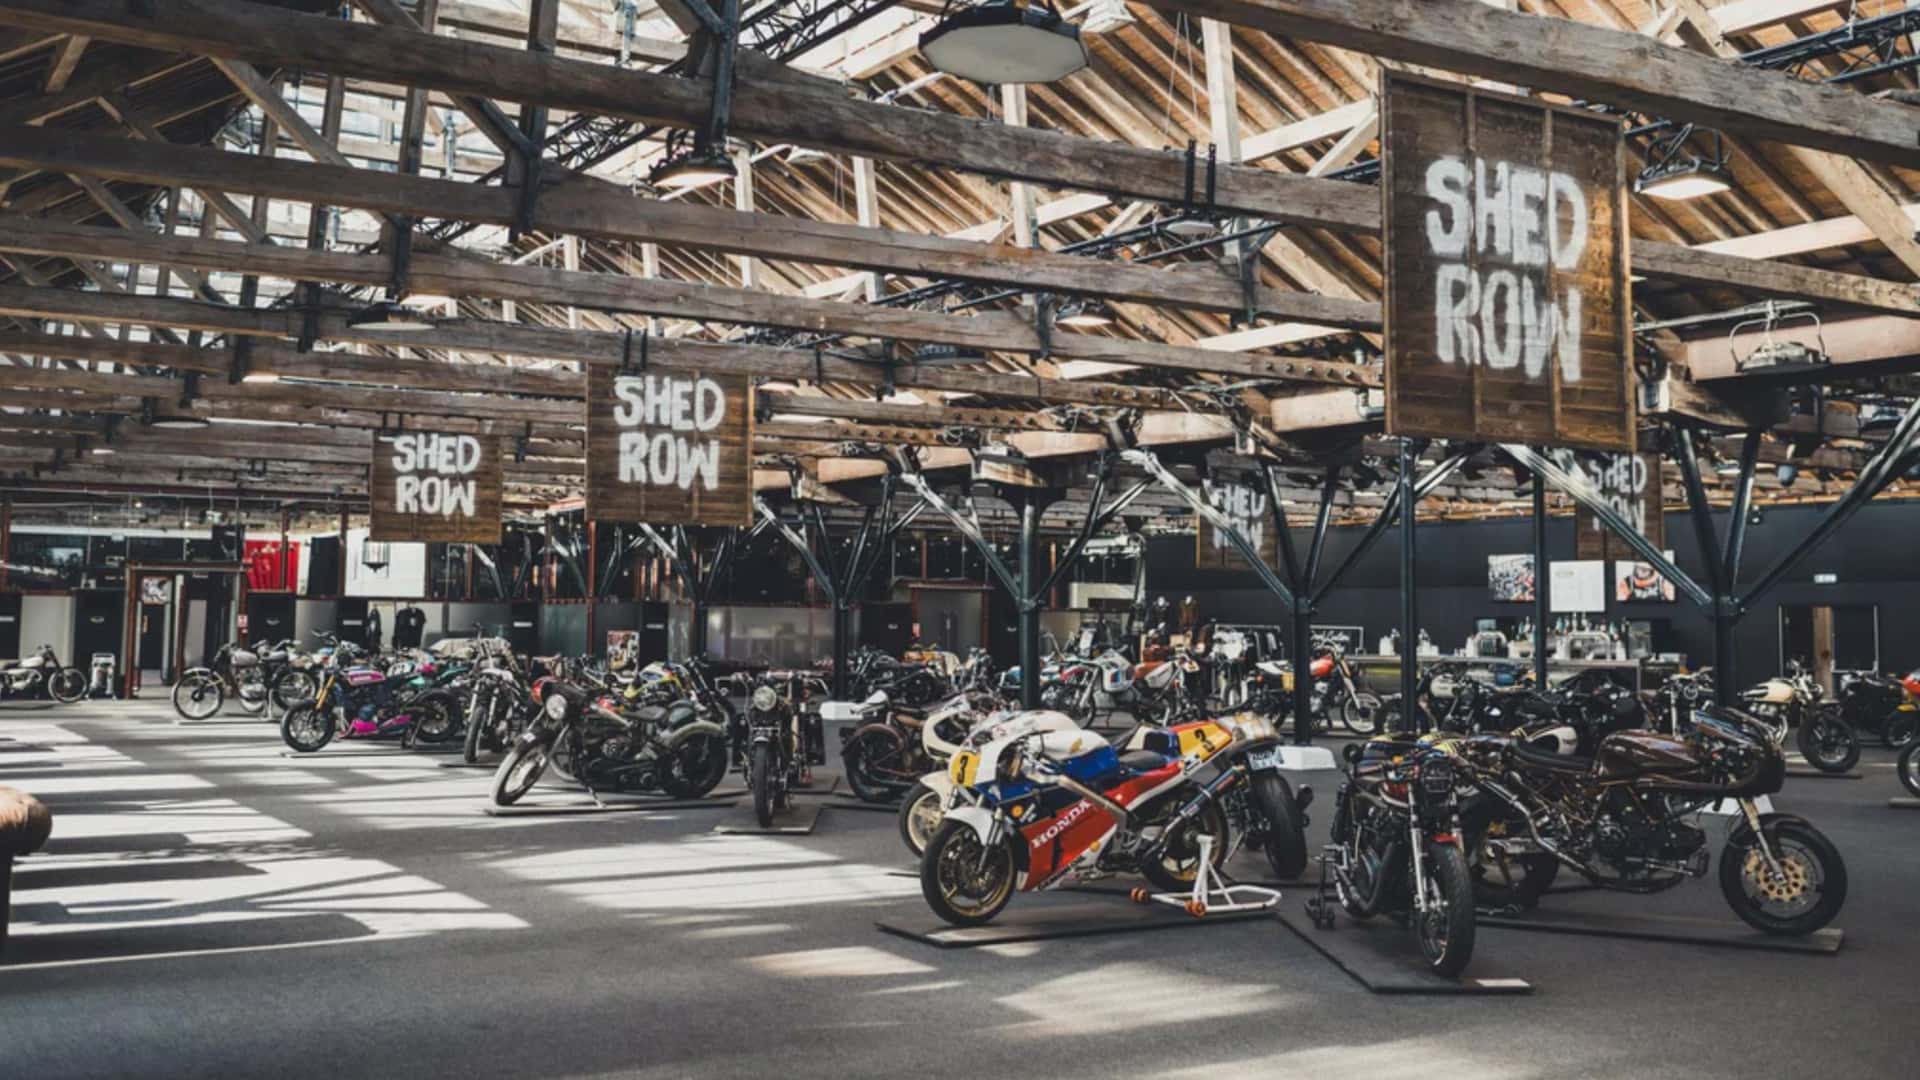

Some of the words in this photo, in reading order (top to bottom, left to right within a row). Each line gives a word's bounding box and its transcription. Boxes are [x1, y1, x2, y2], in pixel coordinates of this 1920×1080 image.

[1425, 155, 1588, 271] SHED
[1435, 264, 1582, 383] ROW
[613, 375, 726, 432] SHED
[391, 433, 481, 474] SHED
[618, 432, 720, 490] ROW
[396, 475, 476, 517] ROW
[1194, 728, 1216, 753] 3
[956, 755, 969, 785] 3
[1031, 800, 1092, 849] HONDA
